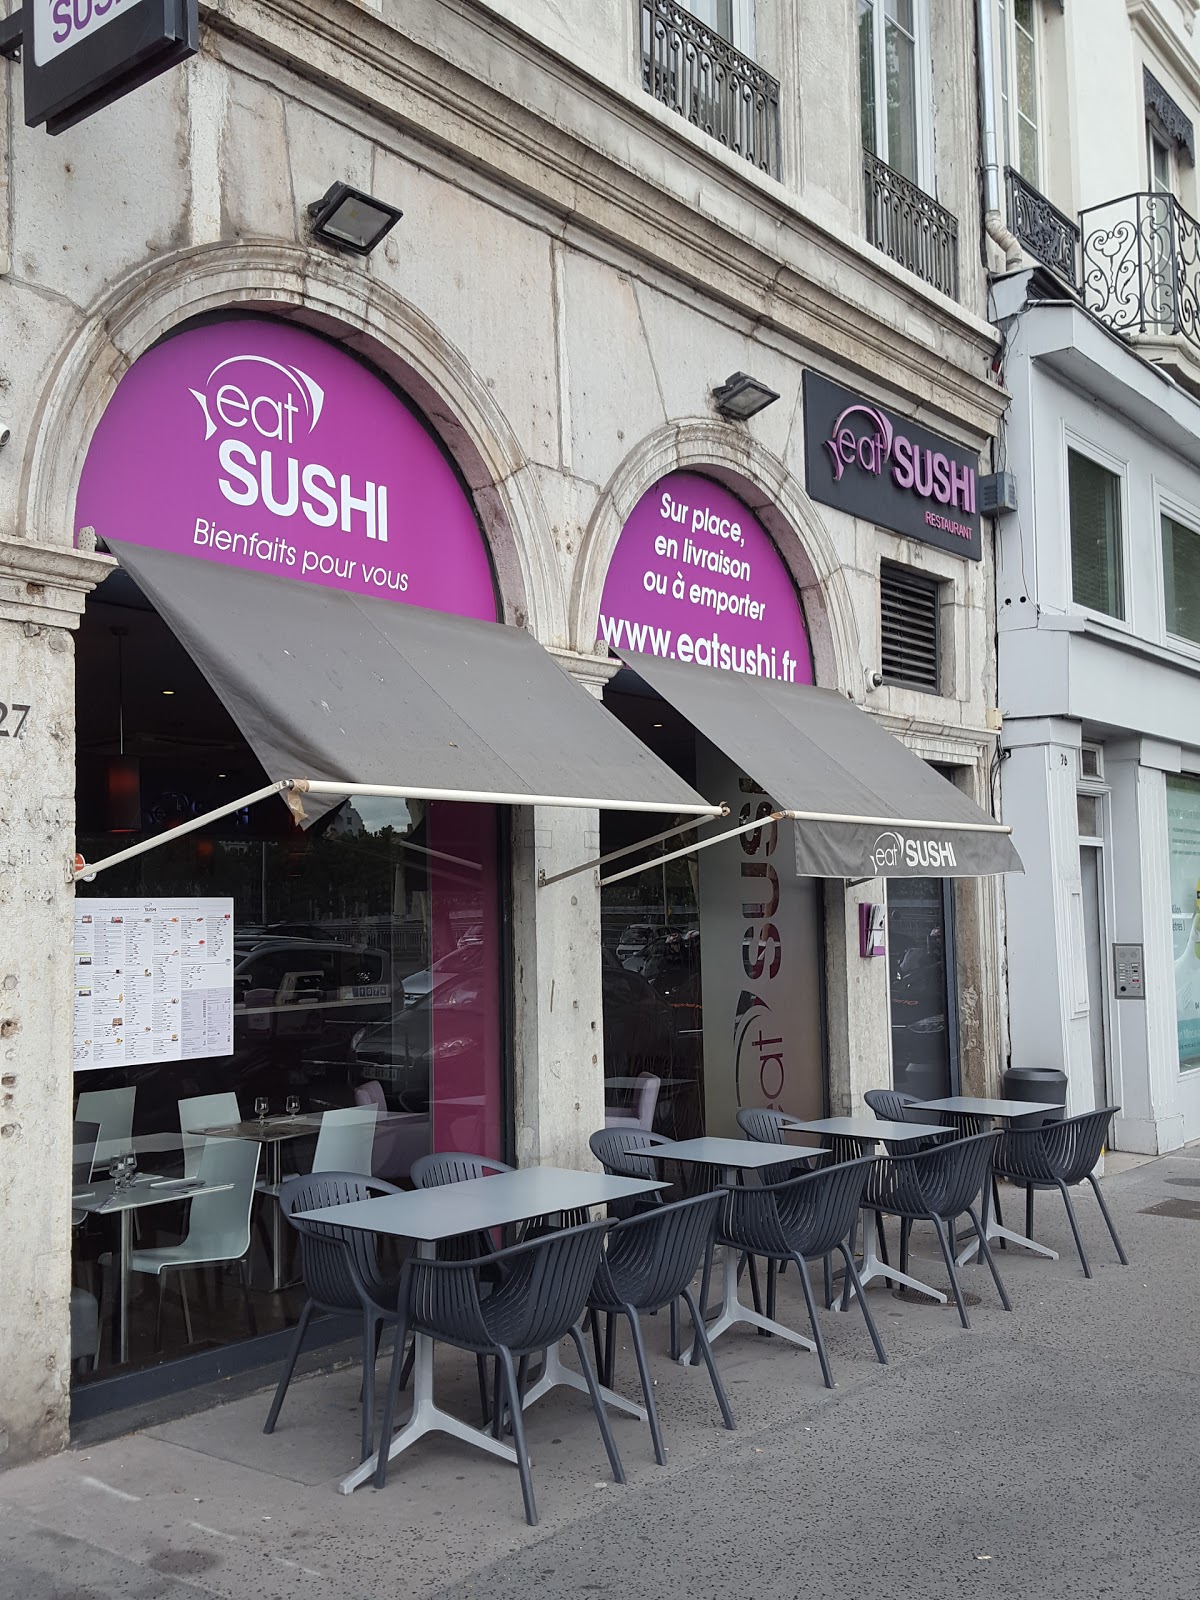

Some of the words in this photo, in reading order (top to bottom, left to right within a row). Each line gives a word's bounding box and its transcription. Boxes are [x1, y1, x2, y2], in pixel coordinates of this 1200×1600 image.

[216, 384, 299, 444] eat
[218, 440, 389, 542] SUSHI
[836, 428, 882, 476] eat
[891, 435, 976, 514] SUSHI
[660, 493, 689, 524] Sur
[691, 507, 745, 548] place,
[924, 511, 973, 541] RESTAURANT
[193, 517, 297, 566] Bienfaits
[302, 547, 357, 580] pour
[361, 564, 410, 592] vous
[654, 535, 678, 560] en
[682, 538, 751, 582] livraison
[643, 571, 668, 595] ou
[672, 570, 686, 600] à
[689, 584, 766, 621] emporter
[600, 614, 797, 683] www.eatsushi.fr
[876, 843, 898, 866] eat
[905, 839, 957, 867] SUSHI
[752, 1030, 784, 1113] at
